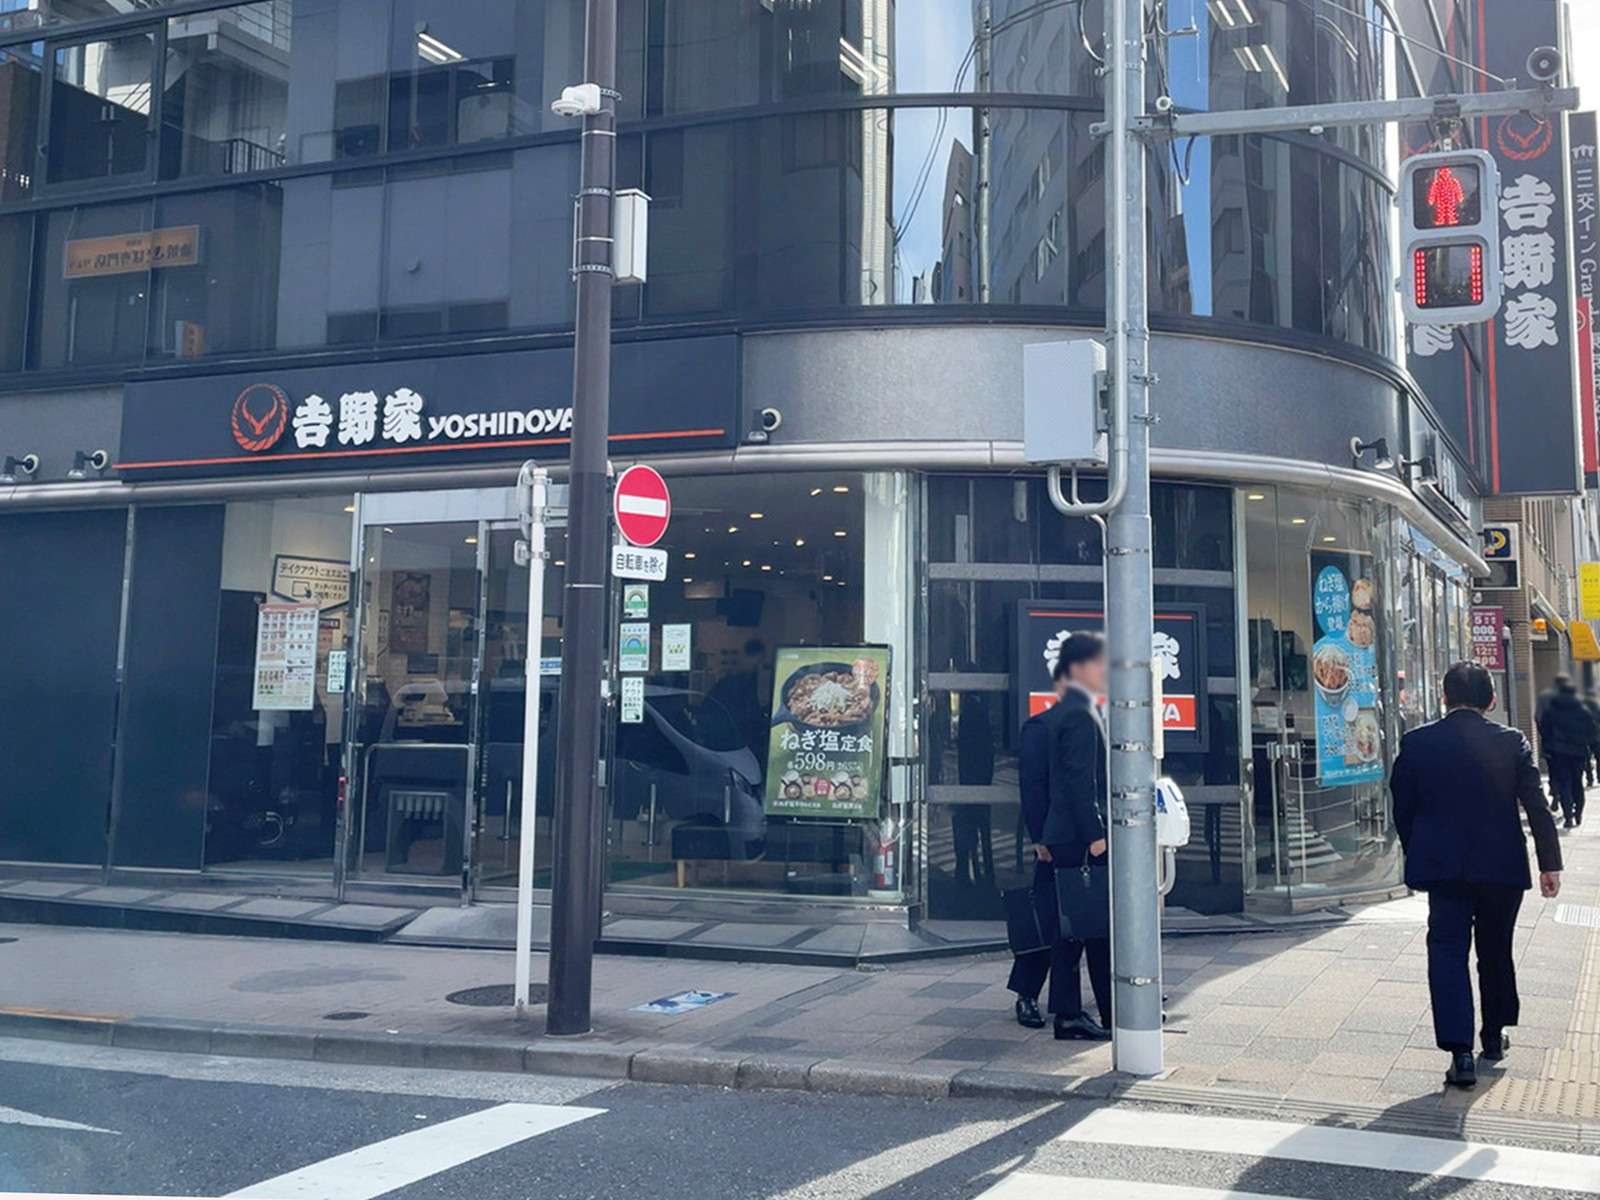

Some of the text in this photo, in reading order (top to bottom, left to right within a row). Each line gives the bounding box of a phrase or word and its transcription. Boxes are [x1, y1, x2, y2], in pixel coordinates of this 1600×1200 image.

[1500, 174, 1558, 349] 吉野家
[292, 387, 423, 448] 吉野家
[616, 553, 665, 577] 自転車を除く
[780, 729, 873, 753] ねぎ塩定食
